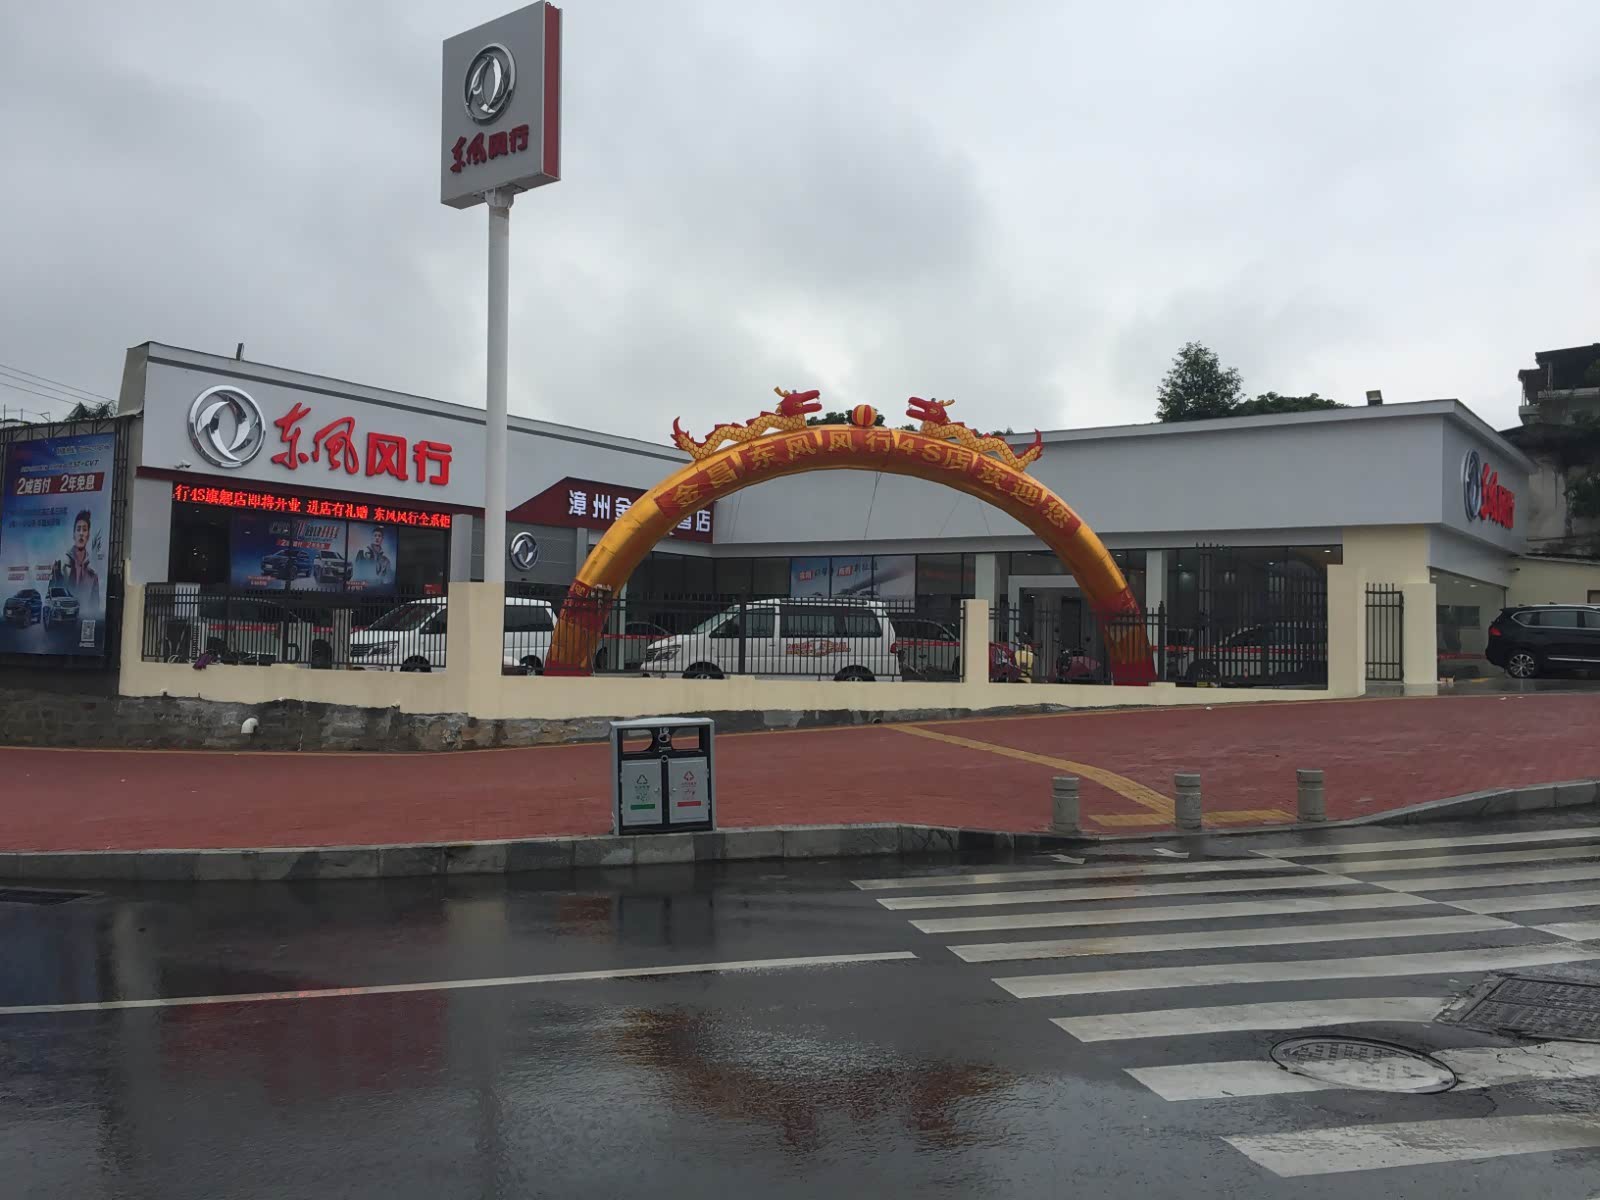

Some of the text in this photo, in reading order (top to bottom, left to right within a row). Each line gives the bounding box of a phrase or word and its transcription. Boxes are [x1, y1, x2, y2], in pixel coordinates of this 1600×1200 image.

[450, 124, 529, 173] 东风风行
[270, 402, 453, 486] 东风风行
[16, 474, 96, 495] 2成首付 2年免息
